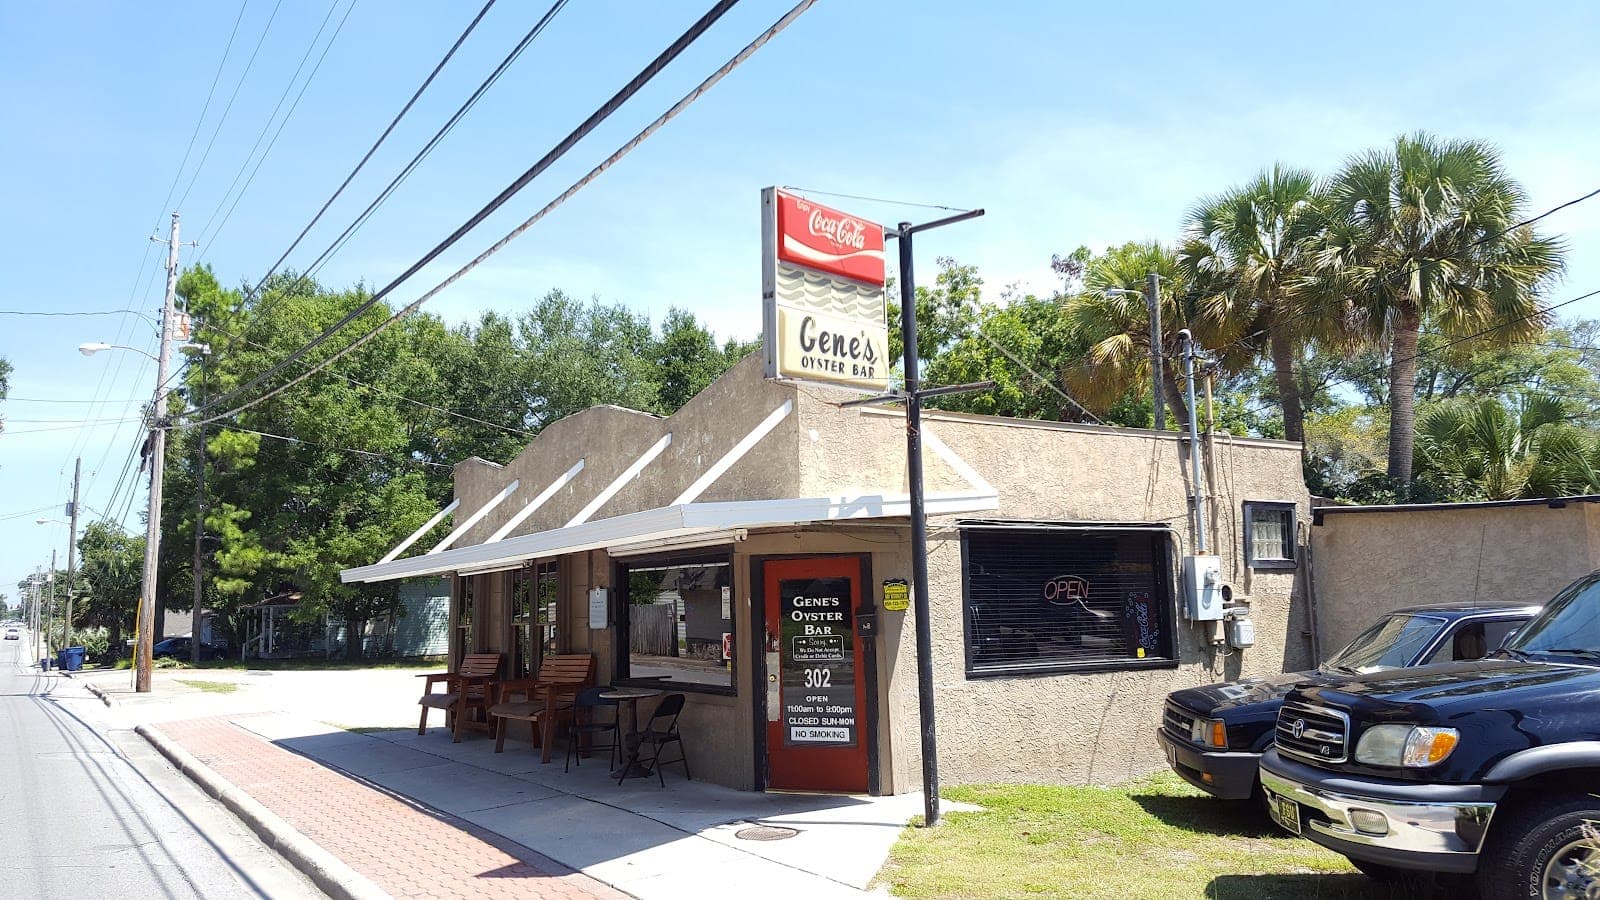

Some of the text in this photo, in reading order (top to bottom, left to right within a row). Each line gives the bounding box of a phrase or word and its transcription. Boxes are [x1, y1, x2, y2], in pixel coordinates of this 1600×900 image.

[800, 315, 878, 366] Gene's
[801, 355, 875, 380] OYSTER BAR
[1044, 580, 1090, 600] OPEN
[791, 610, 844, 622] OYSTER
[804, 624, 833, 636] BAR
[804, 668, 832, 688] 302
[787, 705, 852, 715] 11:00am to 9:00pm
[788, 716, 855, 726] CLOSED SUN-MON
[795, 730, 846, 739] NO SMOKING
